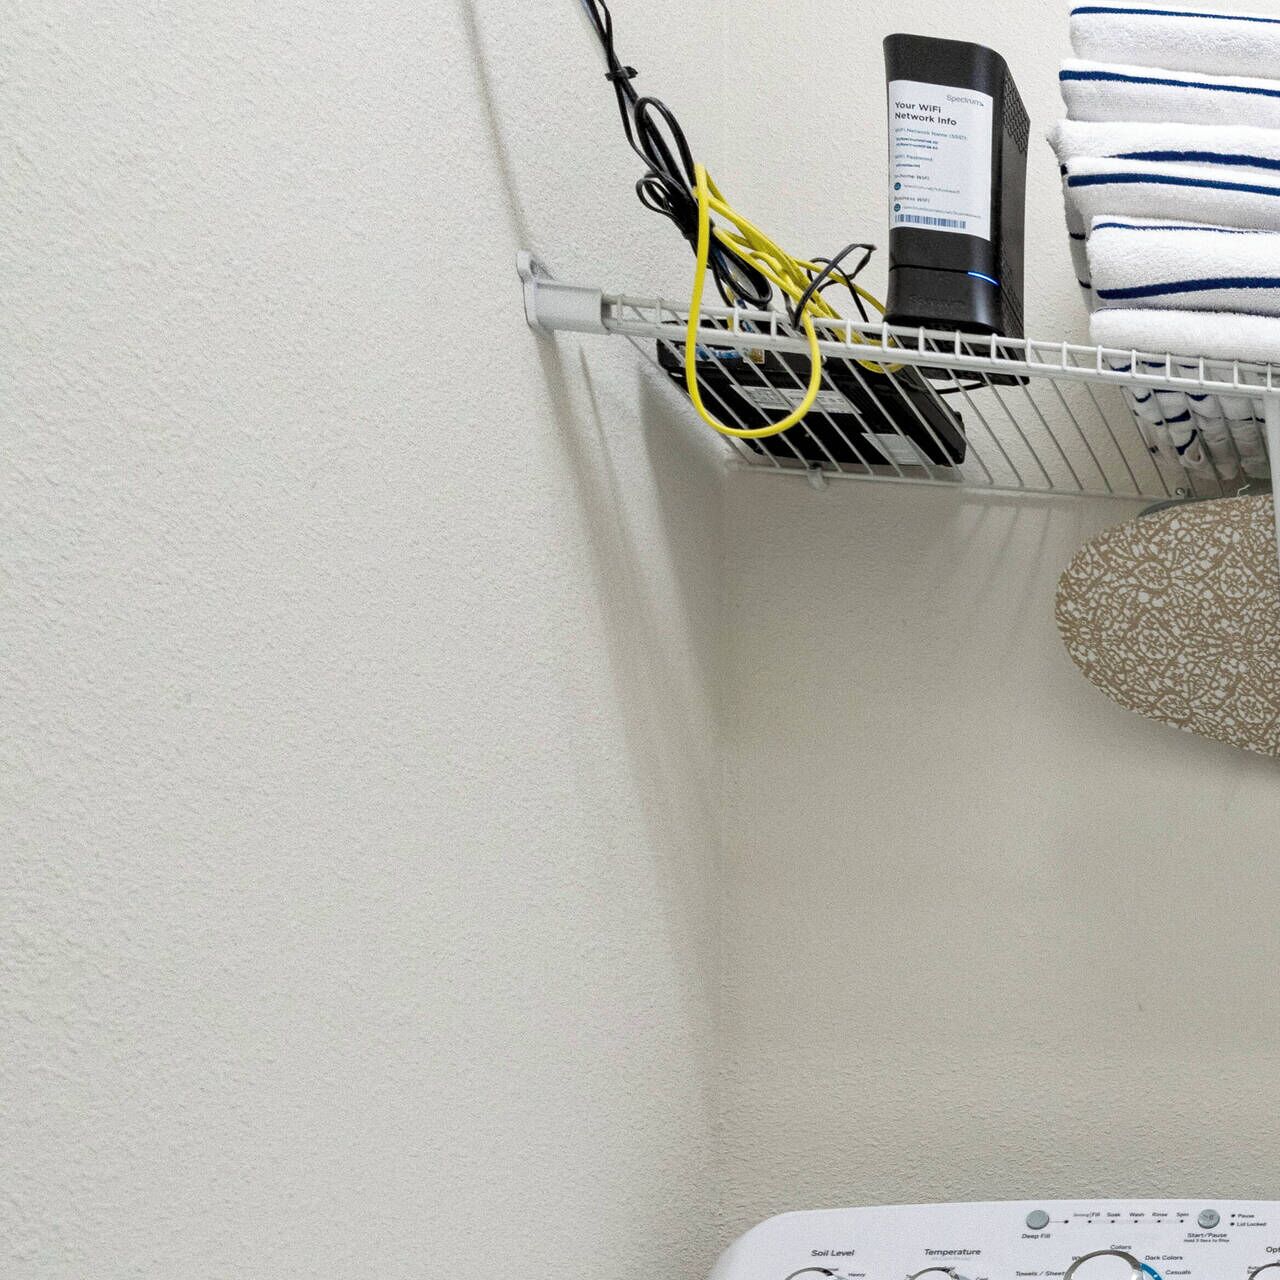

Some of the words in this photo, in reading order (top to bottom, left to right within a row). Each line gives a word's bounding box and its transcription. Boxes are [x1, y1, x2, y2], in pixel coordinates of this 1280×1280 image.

[946, 94, 982, 106] Spectrum
[895, 102, 916, 110] Your
[919, 104, 941, 113] WiFi
[895, 112, 935, 122] Network
[938, 116, 957, 126] Info
[924, 1248, 981, 1256] Temperature
